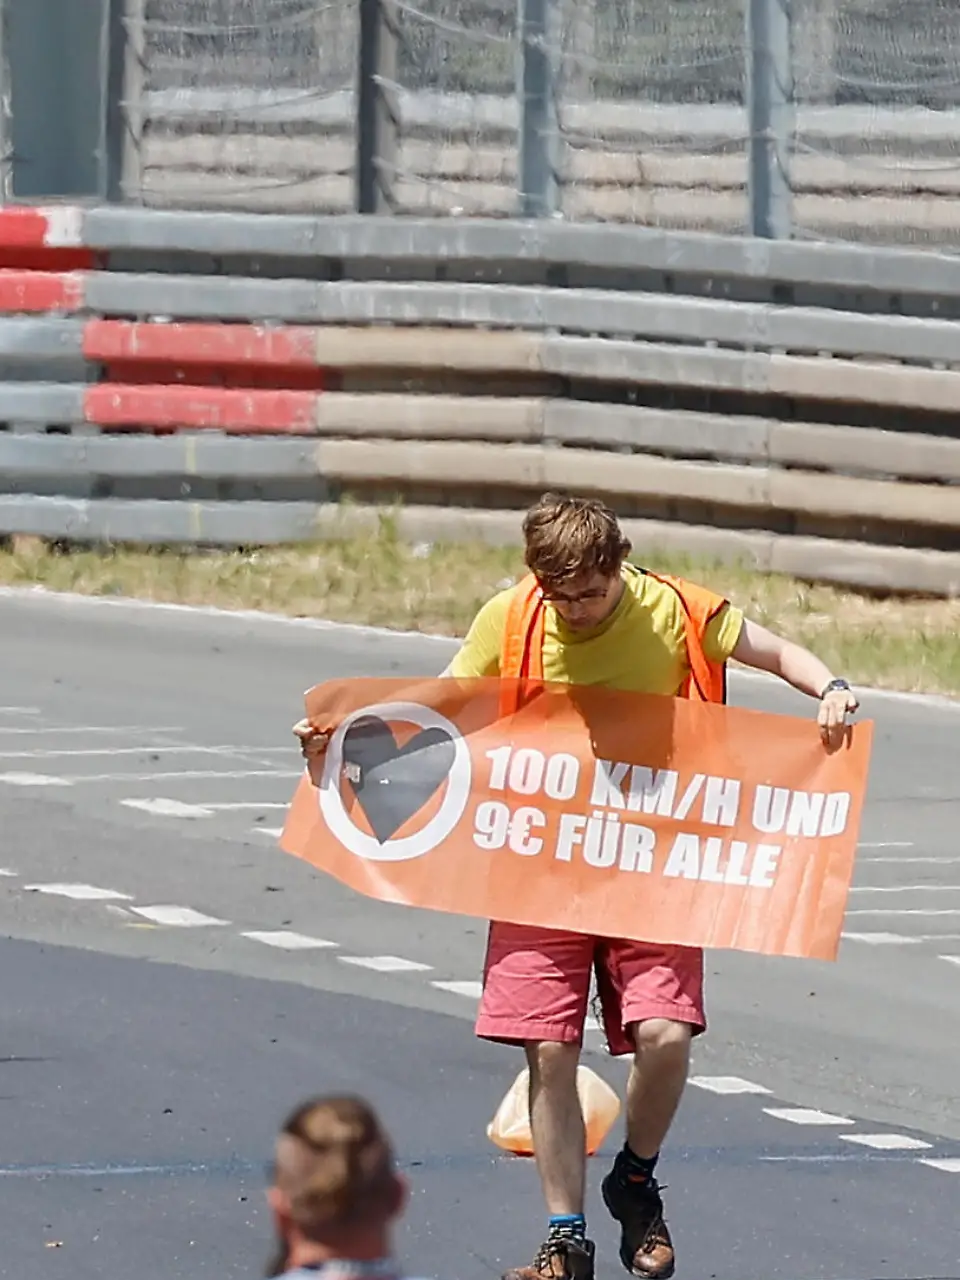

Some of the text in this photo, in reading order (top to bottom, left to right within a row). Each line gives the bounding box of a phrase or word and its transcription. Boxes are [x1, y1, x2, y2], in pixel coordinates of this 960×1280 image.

[485, 746, 851, 837] 100 KM/H UND
[473, 801, 782, 888] 9€ FÜR ALLE
